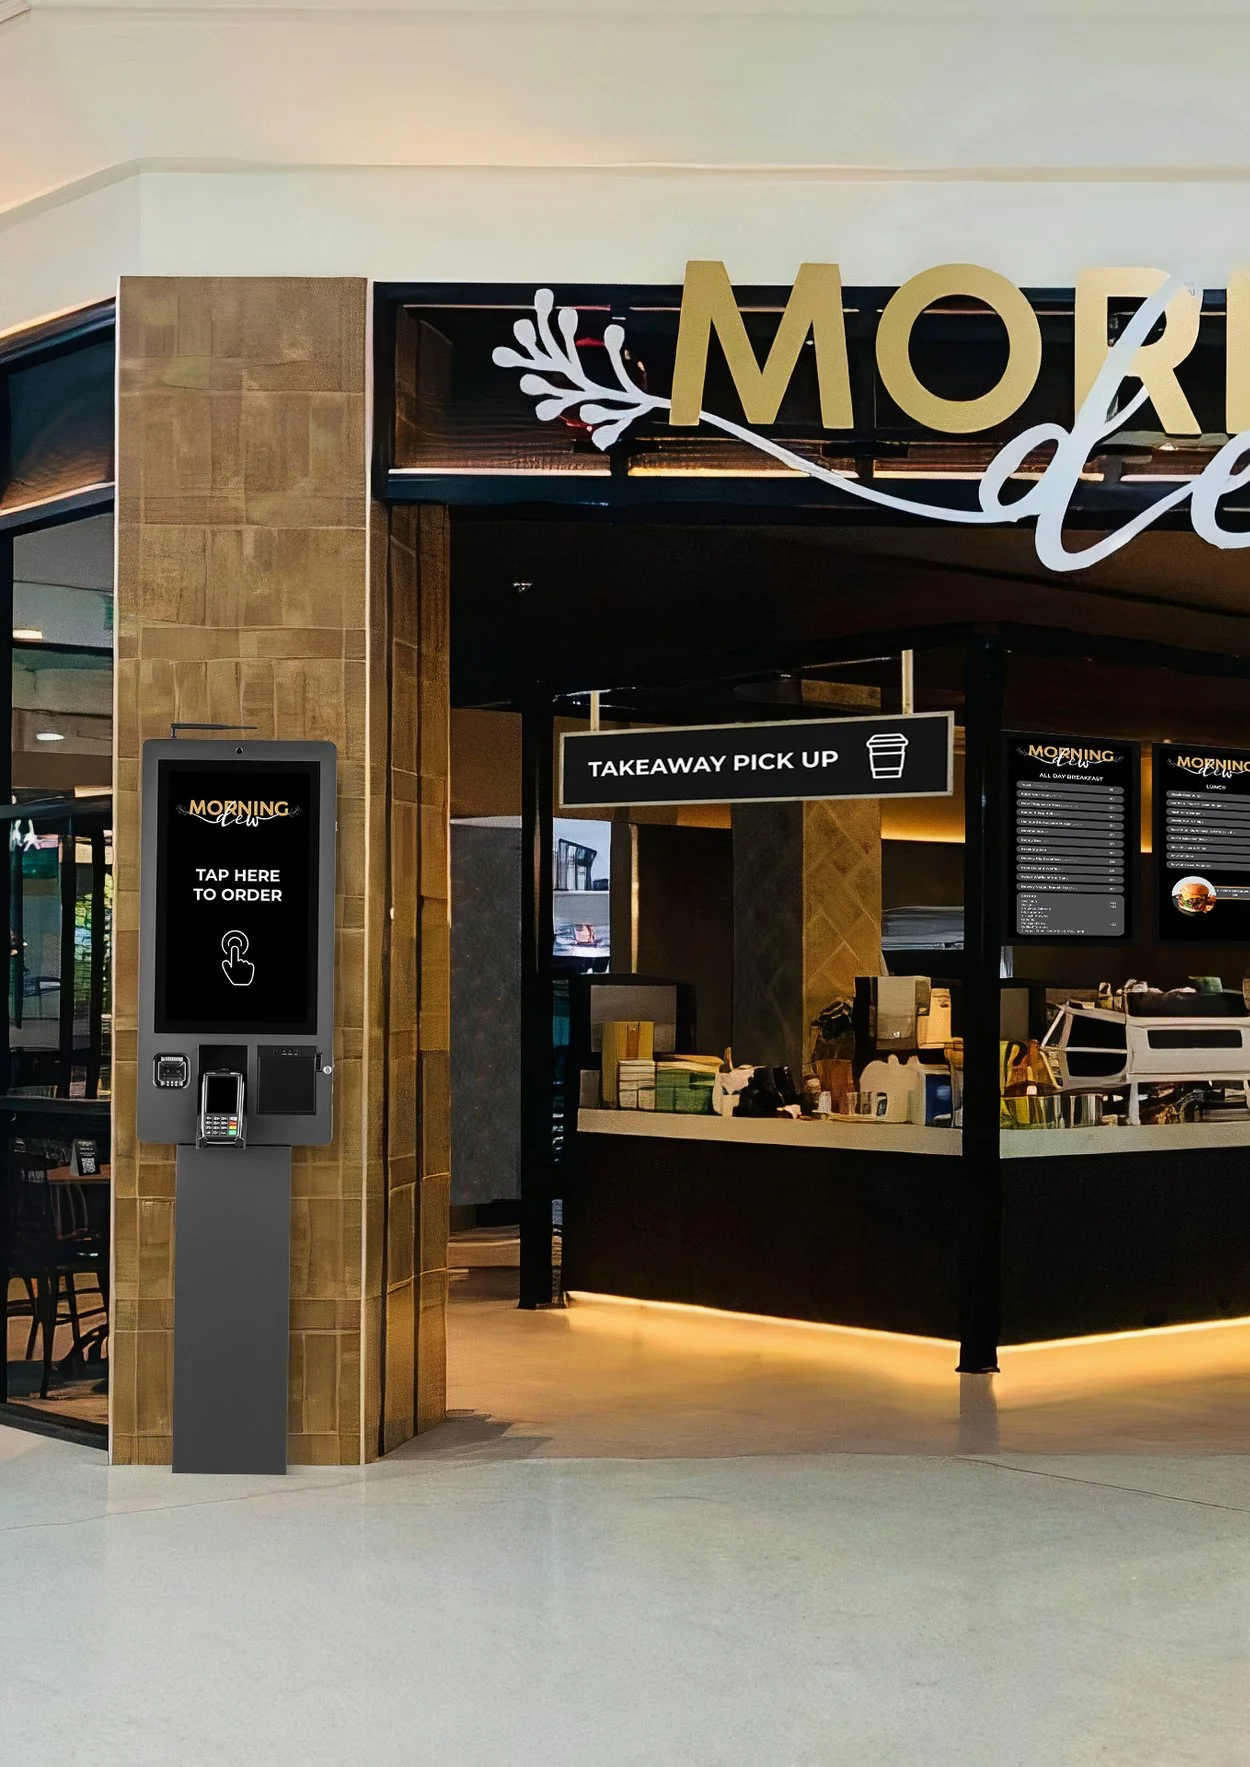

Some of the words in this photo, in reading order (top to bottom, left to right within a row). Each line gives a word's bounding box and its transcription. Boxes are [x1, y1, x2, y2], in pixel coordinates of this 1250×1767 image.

[1028, 744, 1115, 762] MORNING
[588, 755, 727, 778] TAKEAWAY
[733, 752, 795, 772] PICK
[802, 750, 839, 769] UP
[1066, 774, 1104, 782] BREAKFAST
[189, 799, 288, 817] MORNING
[196, 868, 229, 883] TAP
[235, 868, 280, 883] HERE
[193, 888, 216, 902] TO
[221, 888, 282, 902] ORDER
